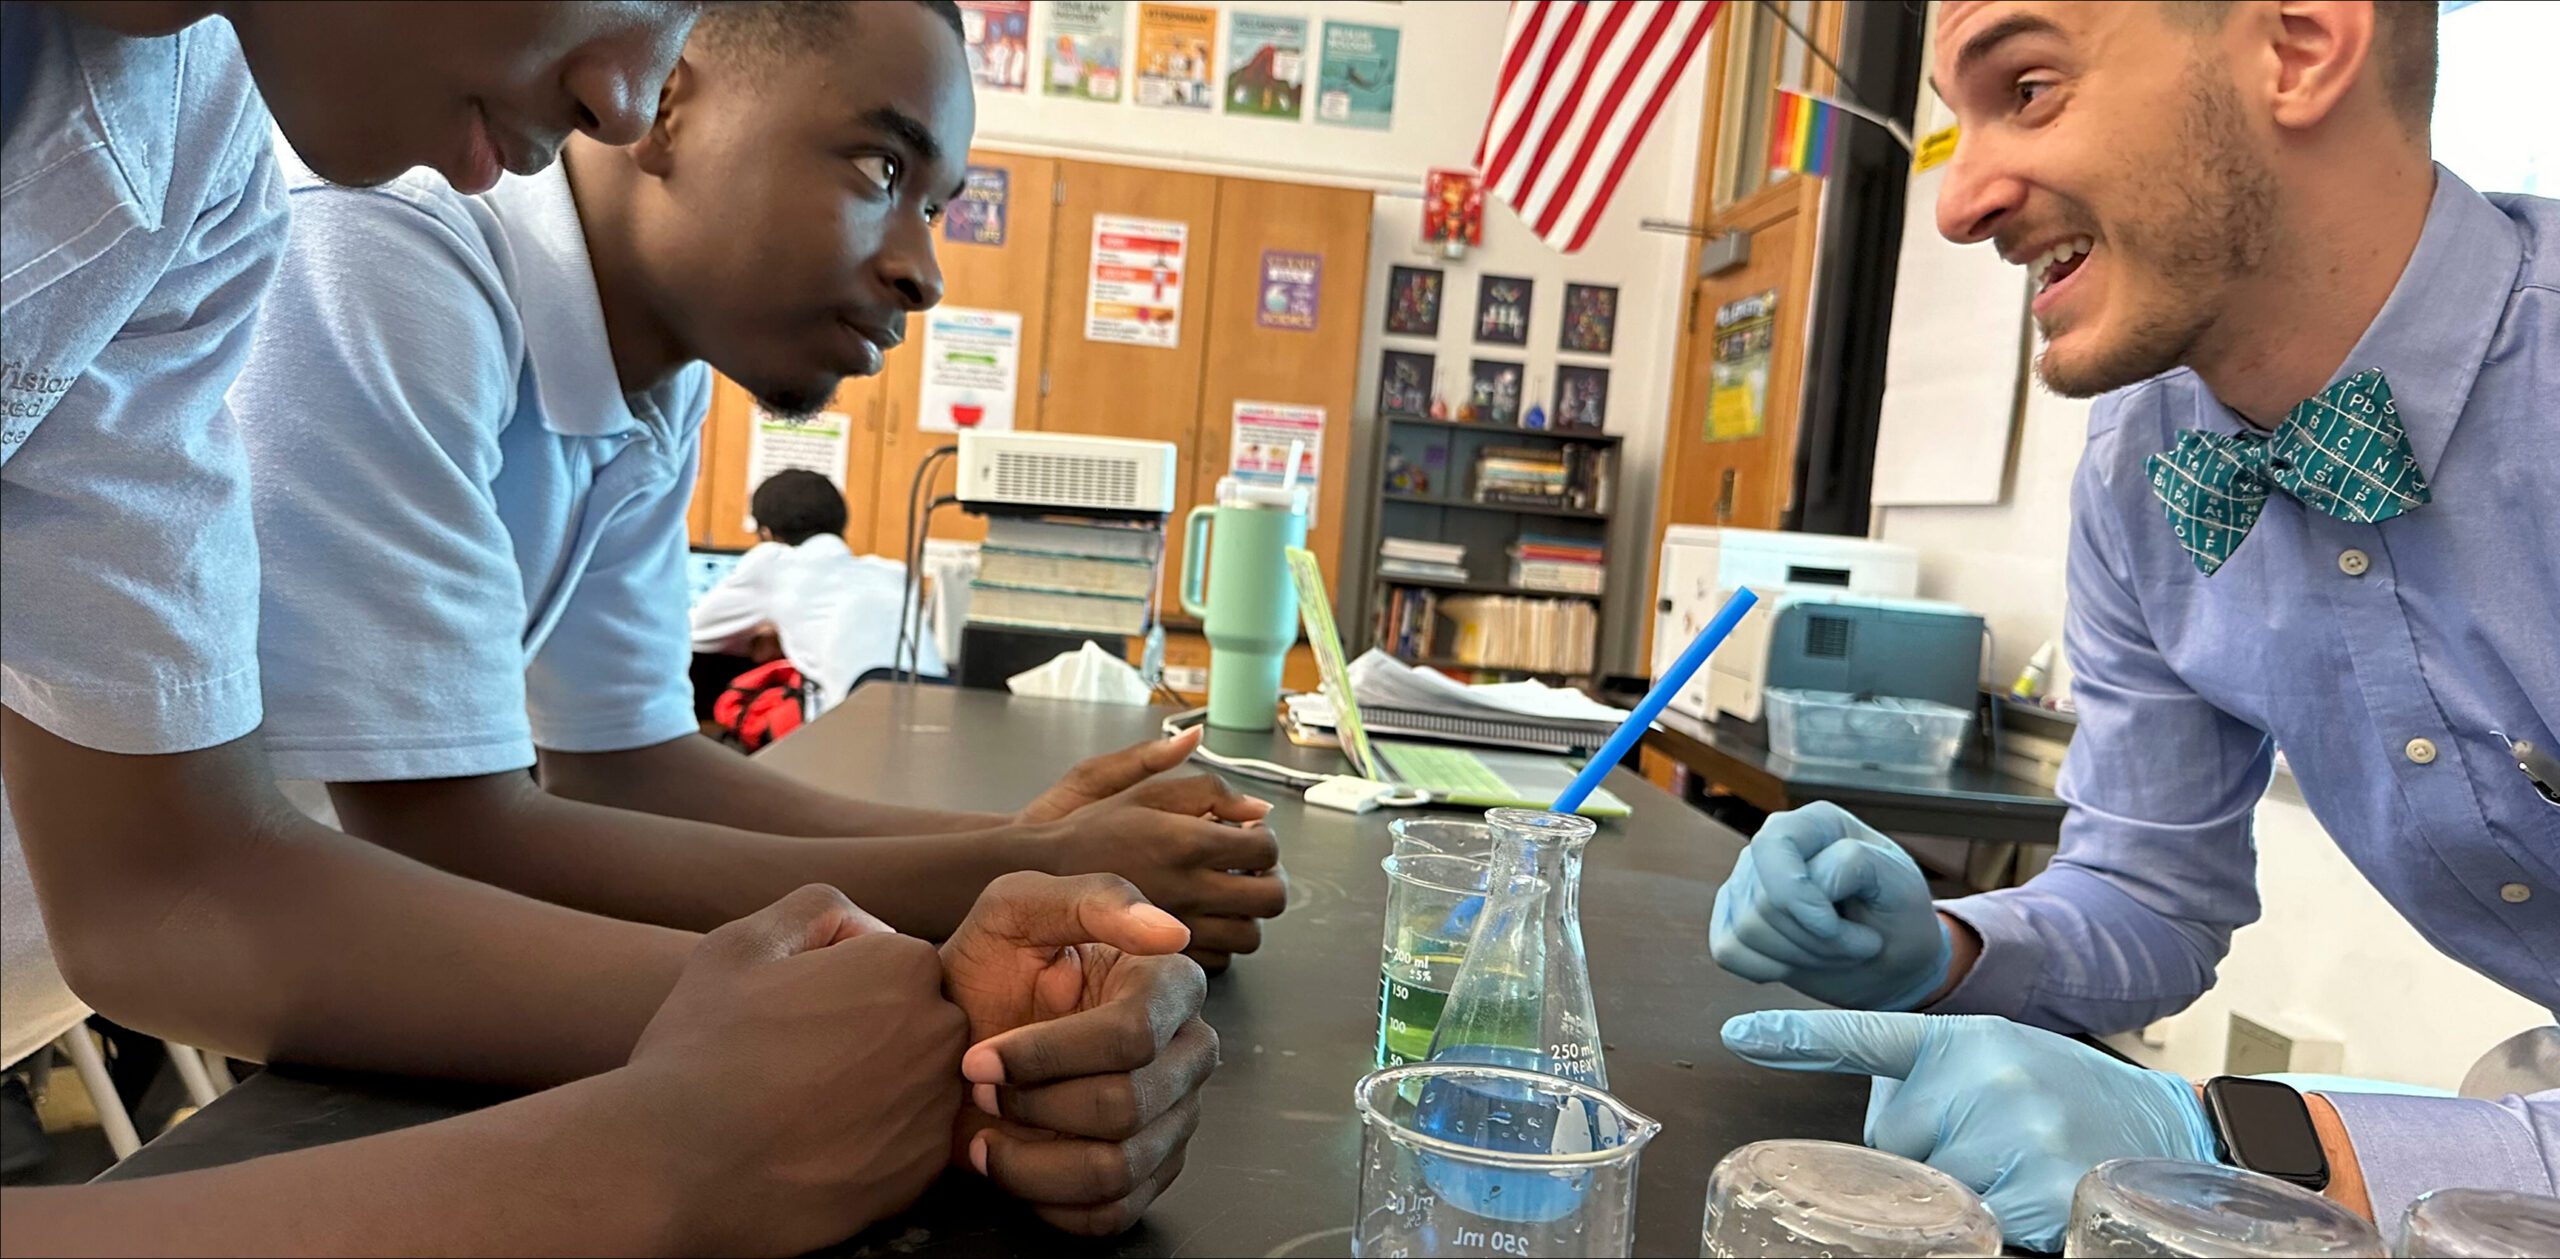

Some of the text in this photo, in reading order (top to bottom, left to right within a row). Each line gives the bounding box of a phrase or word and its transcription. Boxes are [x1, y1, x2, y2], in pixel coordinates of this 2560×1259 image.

[2349, 393, 2375, 414] Pb
[2309, 415, 2320, 430] B
[2337, 436, 2351, 451] C
[2186, 452, 2199, 471] Te
[2372, 456, 2390, 473] N
[2154, 473, 2166, 489] Bi
[2314, 470, 2333, 485] Si
[2174, 490, 2190, 507] Po
[2354, 491, 2367, 502] P
[2203, 505, 2223, 518] At
[2174, 525, 2185, 538] O
[2205, 539, 2215, 549] F
[1393, 947, 1411, 965] 200
[1391, 983, 1409, 1000] 150
[1390, 1016, 1406, 1034] 100
[1550, 1043, 1579, 1060] 250
[1390, 1053, 1403, 1067] 50
